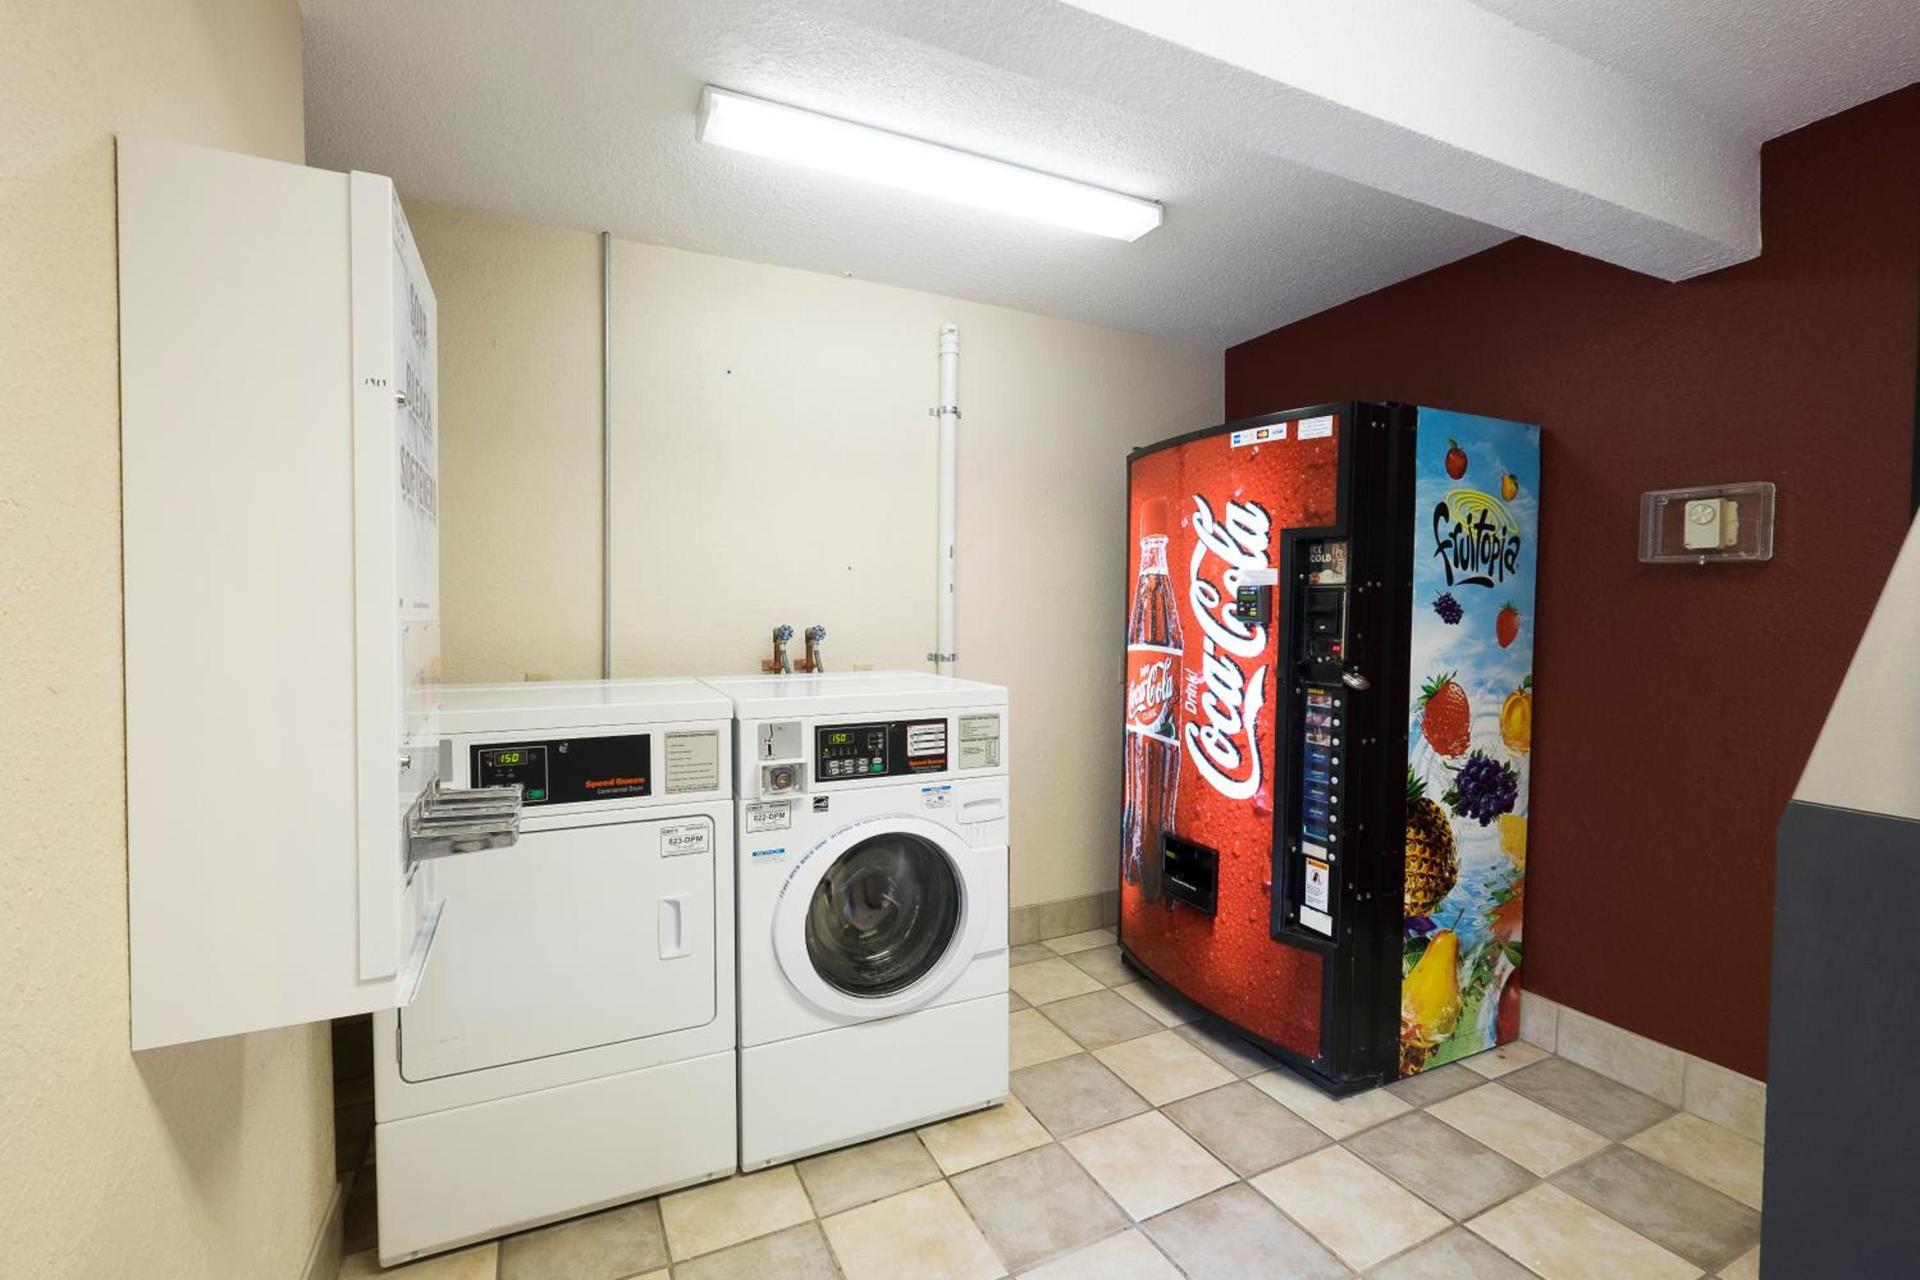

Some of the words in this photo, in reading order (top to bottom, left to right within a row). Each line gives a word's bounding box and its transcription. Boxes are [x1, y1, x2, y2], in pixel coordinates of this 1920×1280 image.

[1310, 553, 1332, 563] COLD
[1185, 667, 1197, 715] Drink!
[501, 753, 519, 763] 150
